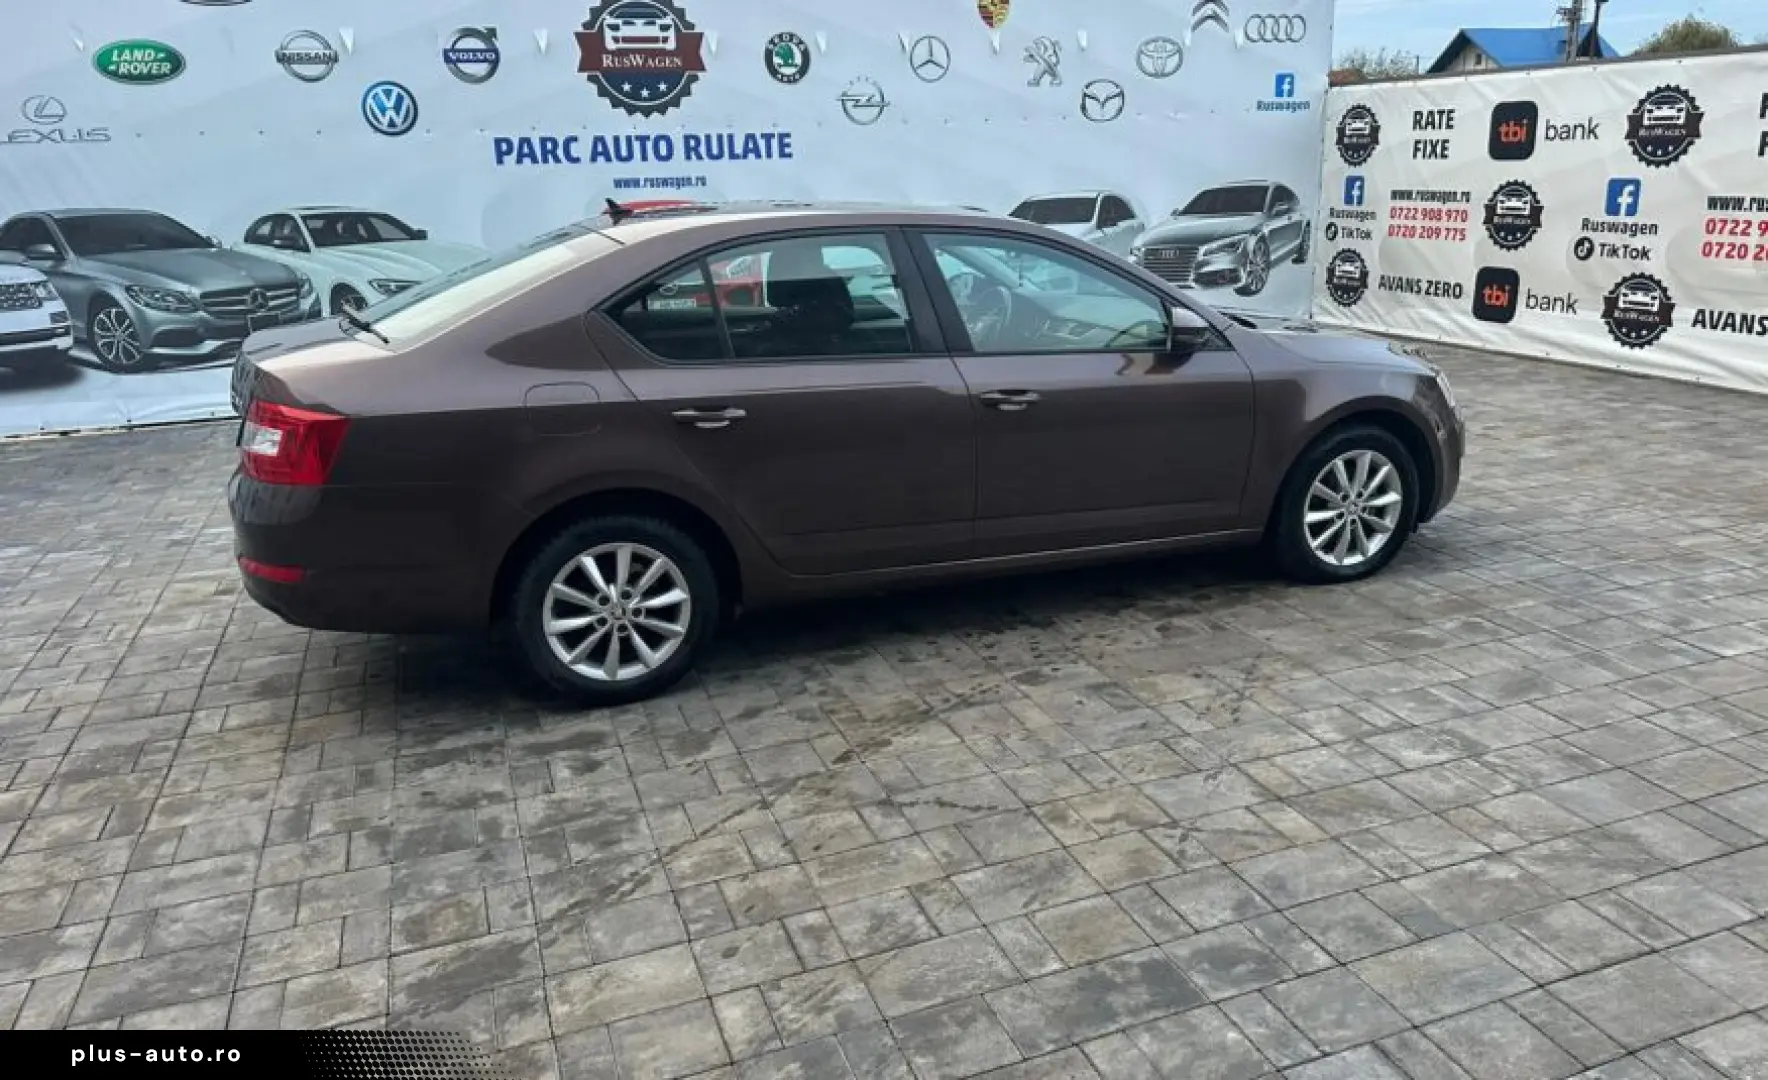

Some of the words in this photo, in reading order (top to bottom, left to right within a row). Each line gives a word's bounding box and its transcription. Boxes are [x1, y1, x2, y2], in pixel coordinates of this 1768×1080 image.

[111, 48, 155, 61] LAND
[447, 51, 496, 61] VOLVO
[119, 62, 172, 75] ROVER
[1412, 109, 1455, 131] RATE
[1499, 118, 1528, 143] tbi
[1544, 117, 1600, 141] bank
[494, 136, 582, 165] PARC
[590, 133, 674, 164] AUTO
[683, 131, 794, 161] RULATE
[1412, 139, 1450, 160] FIXE
[613, 175, 707, 190] www.ruswagen.ro
[1390, 206, 1418, 221] 0722
[1444, 209, 1468, 223] 970
[1341, 226, 1373, 240] TikTok
[1388, 223, 1416, 239] 0720
[1418, 225, 1441, 240] 209
[1444, 227, 1467, 242] 775
[1581, 217, 1658, 237] Ruswagen
[1705, 218, 1752, 237] 0722
[1599, 242, 1651, 261] TikTok
[1701, 241, 1748, 260] 0720
[1378, 274, 1422, 295] AVANS
[1424, 280, 1462, 299] ZERO
[1483, 284, 1511, 307] tbi
[1525, 287, 1579, 315] bank
[1690, 308, 1768, 337] AVANS
